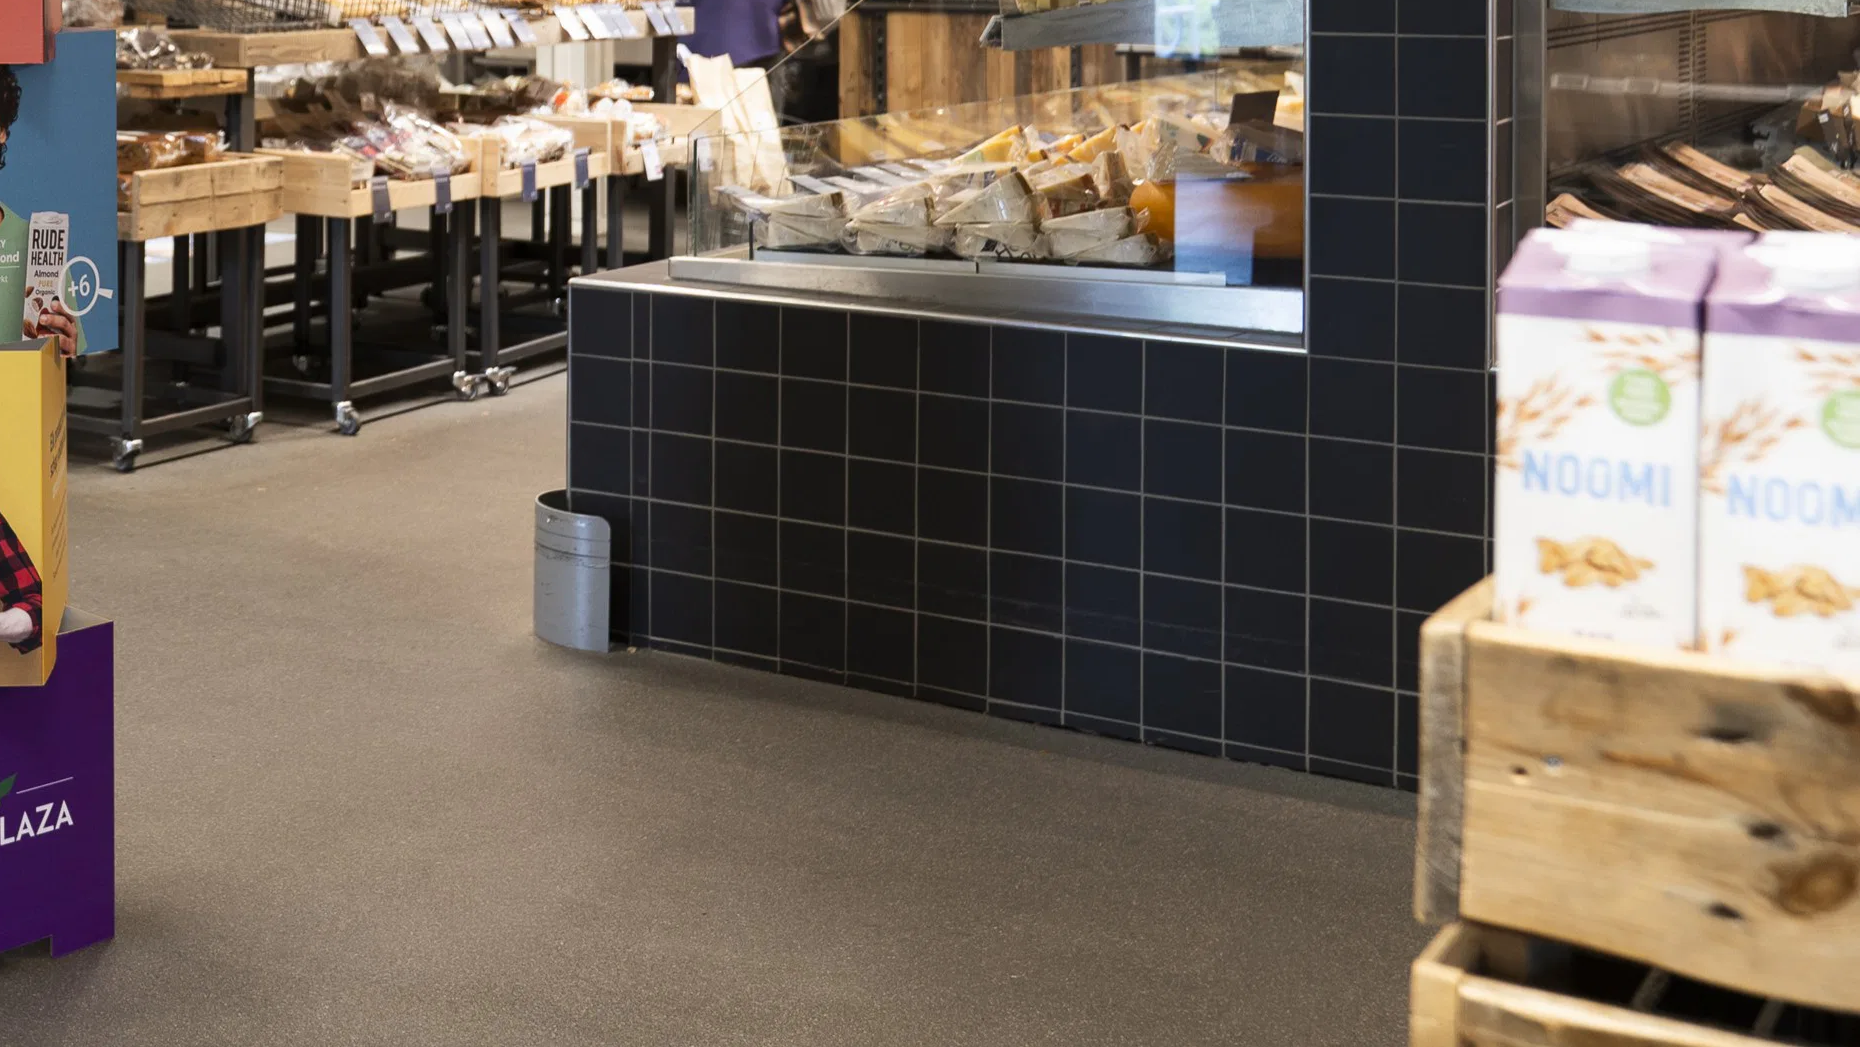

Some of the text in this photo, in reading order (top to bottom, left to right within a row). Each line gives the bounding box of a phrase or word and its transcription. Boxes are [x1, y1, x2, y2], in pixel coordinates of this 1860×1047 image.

[32, 229, 65, 250] RUDE
[31, 251, 64, 266] HEALTH
[34, 270, 59, 279] Almond
[68, 273, 90, 298] +6
[1521, 449, 1675, 509] NOOMI
[1726, 473, 1860, 530] NOOM
